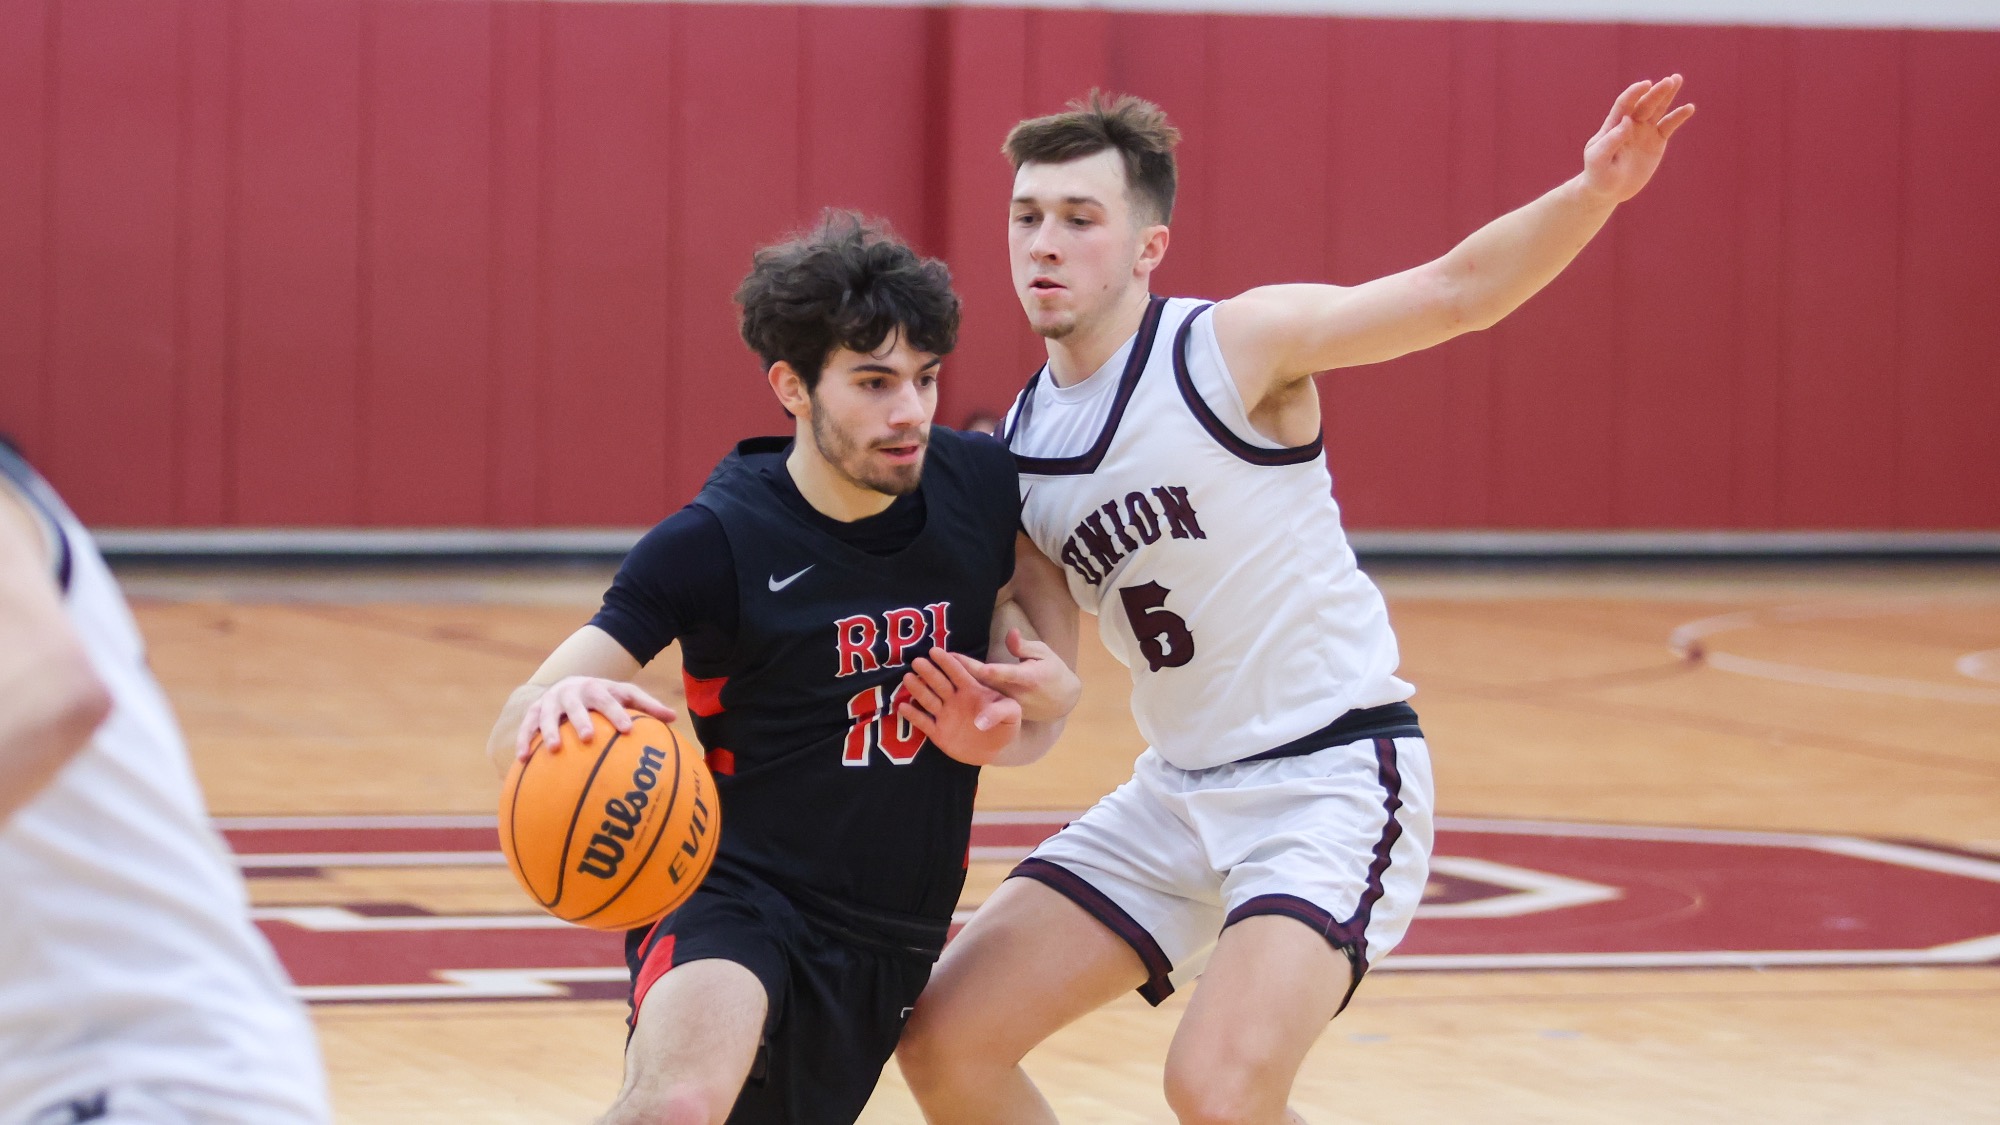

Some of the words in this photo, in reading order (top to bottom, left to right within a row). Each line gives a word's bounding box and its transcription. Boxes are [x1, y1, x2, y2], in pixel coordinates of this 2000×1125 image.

[1061, 485, 1207, 586] UNION
[833, 601, 950, 678] RPI
[1118, 579, 1195, 673] 5
[576, 744, 667, 880] Wilson
